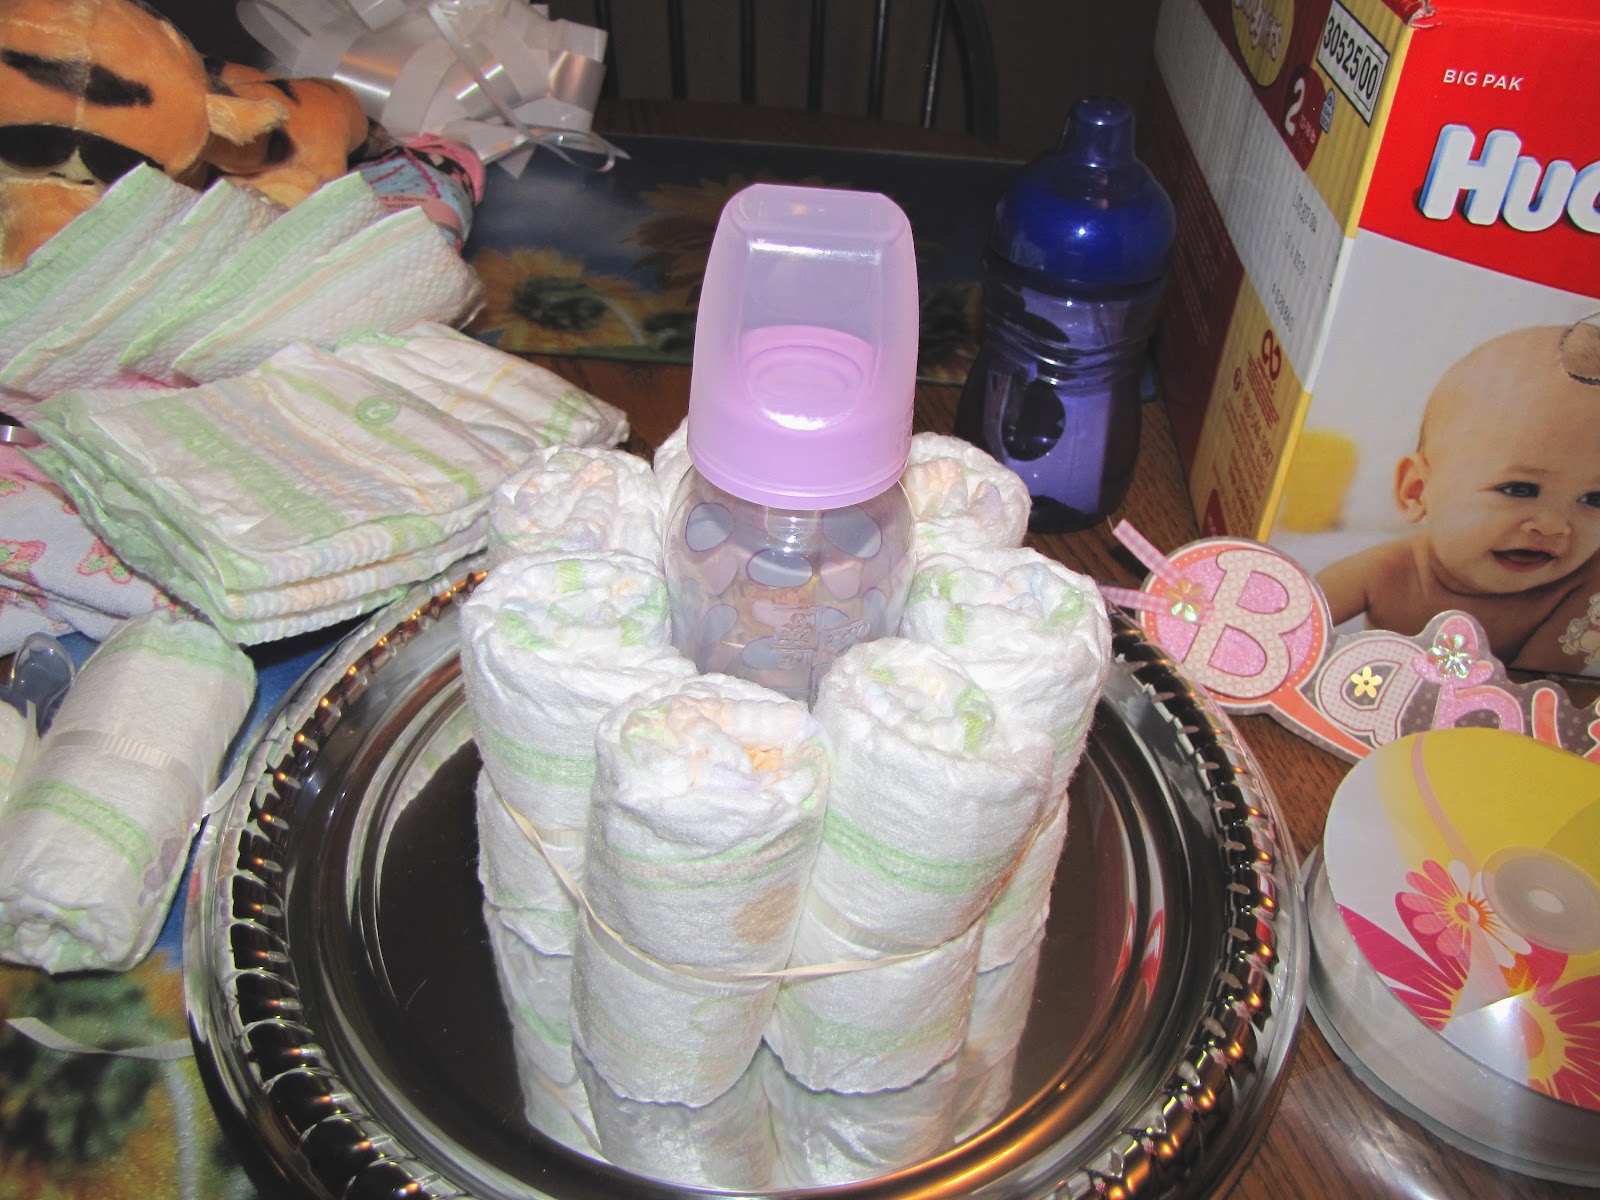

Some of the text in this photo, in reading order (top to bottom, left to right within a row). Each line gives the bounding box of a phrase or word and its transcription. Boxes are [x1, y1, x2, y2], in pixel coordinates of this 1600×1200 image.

[1322, 16, 1379, 100] 3052500
[1443, 69, 1524, 91] BIG PAK
[1285, 78, 1306, 136] 2
